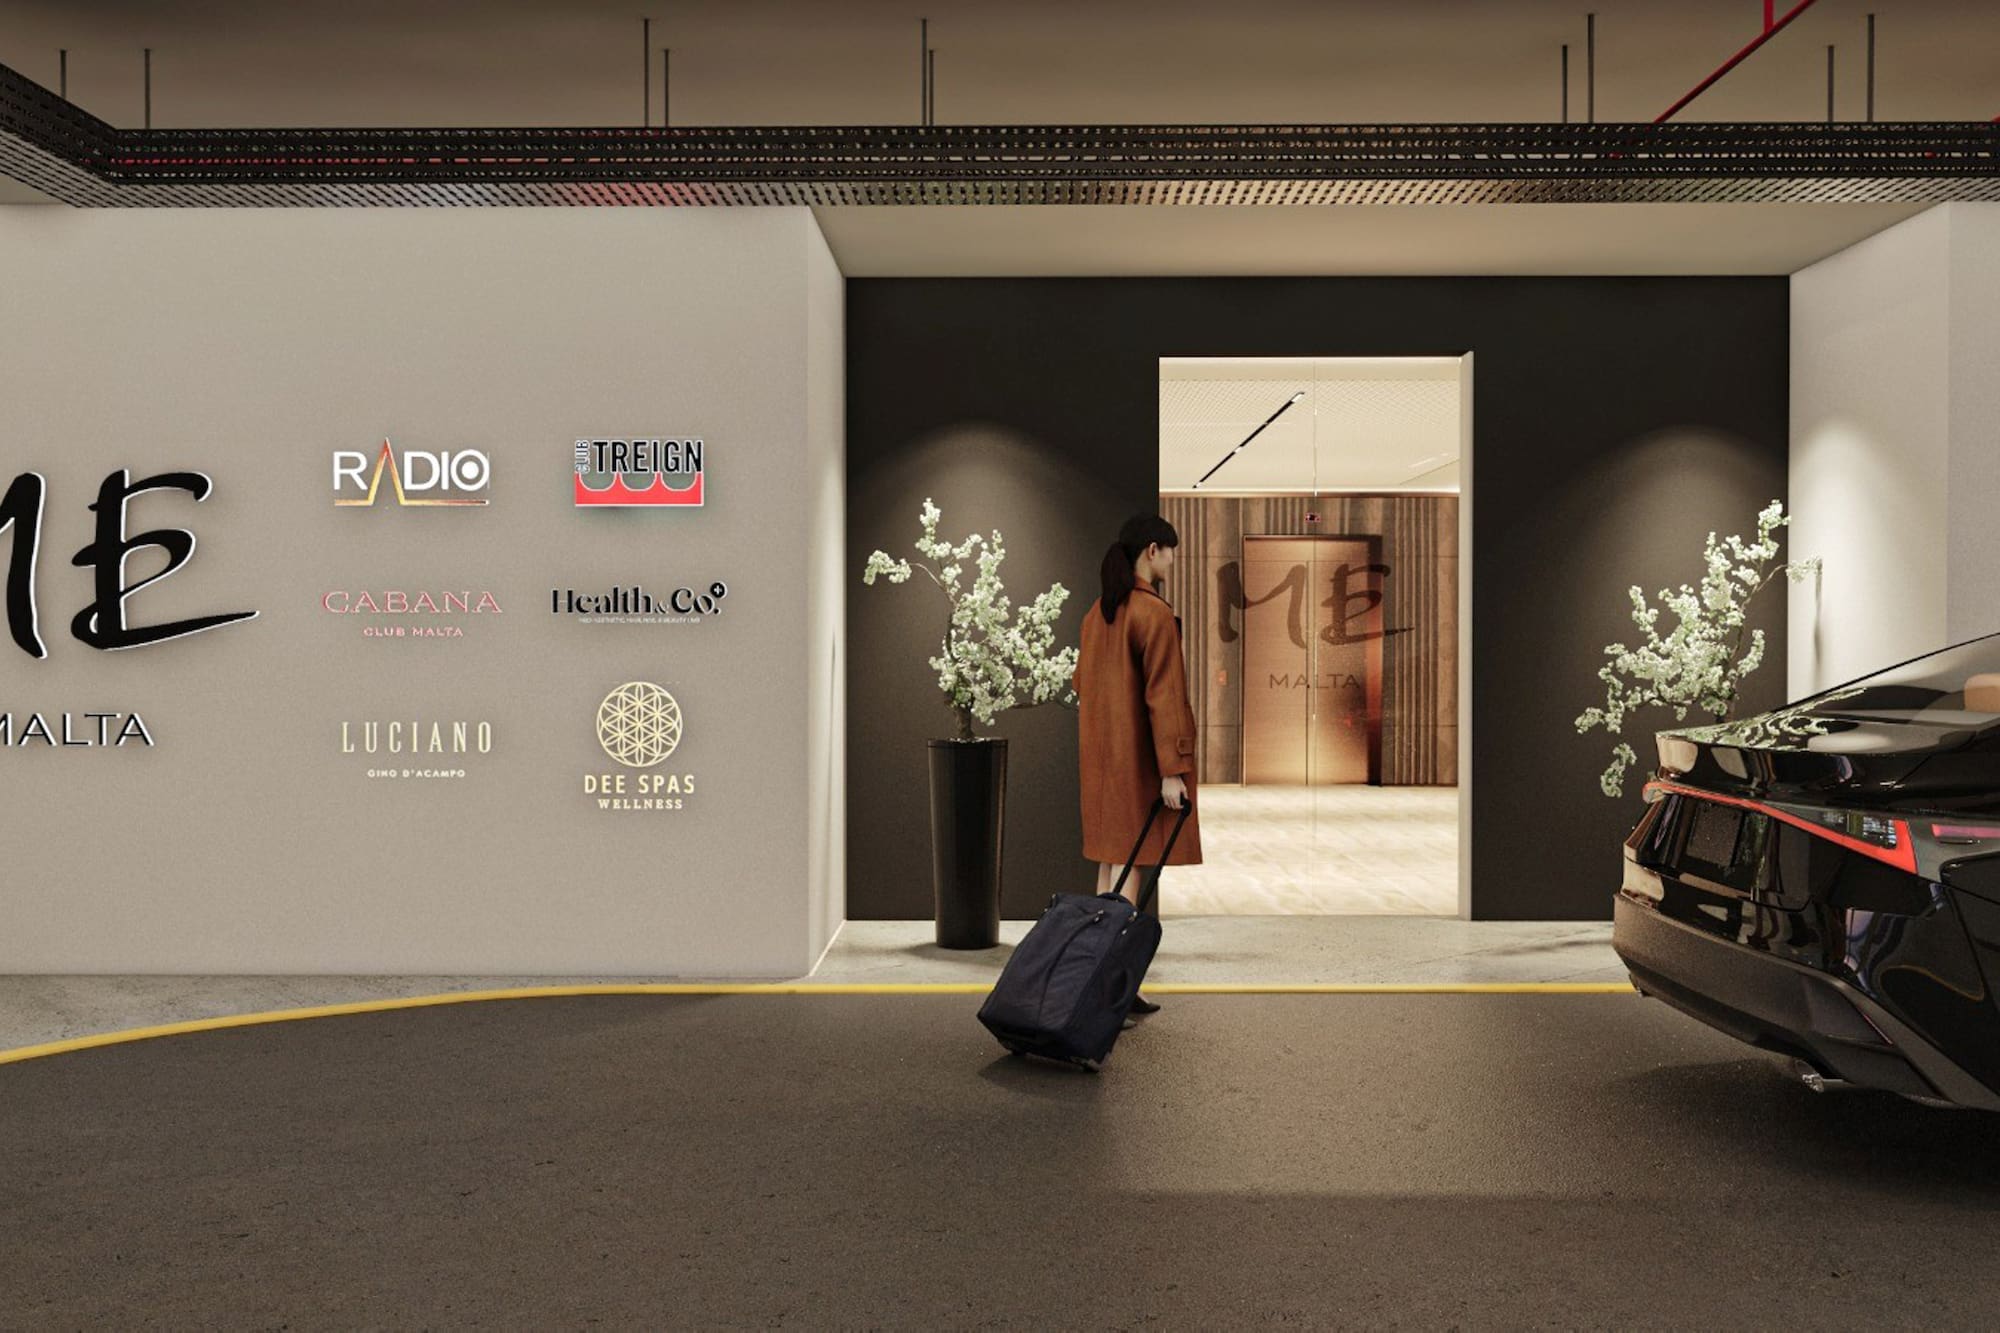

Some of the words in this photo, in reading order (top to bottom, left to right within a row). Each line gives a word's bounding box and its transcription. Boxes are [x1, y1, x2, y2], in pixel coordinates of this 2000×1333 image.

[592, 440, 704, 473] TREIGN
[333, 437, 490, 506] RADIO
[0, 469, 260, 659] E
[323, 591, 503, 614] CABANA
[552, 585, 655, 614] Health
[1216, 561, 1415, 650] ME
[363, 626, 405, 637] CLUB
[412, 626, 463, 637] MALTA
[1269, 674, 1361, 689] MALTA
[342, 721, 491, 753] LUCIANO
[367, 769, 397, 778] GINO
[402, 769, 466, 778] D'ACAMPO
[584, 774, 626, 794] DEE
[638, 774, 695, 794] SPAS
[598, 799, 683, 810] WELLNESS
